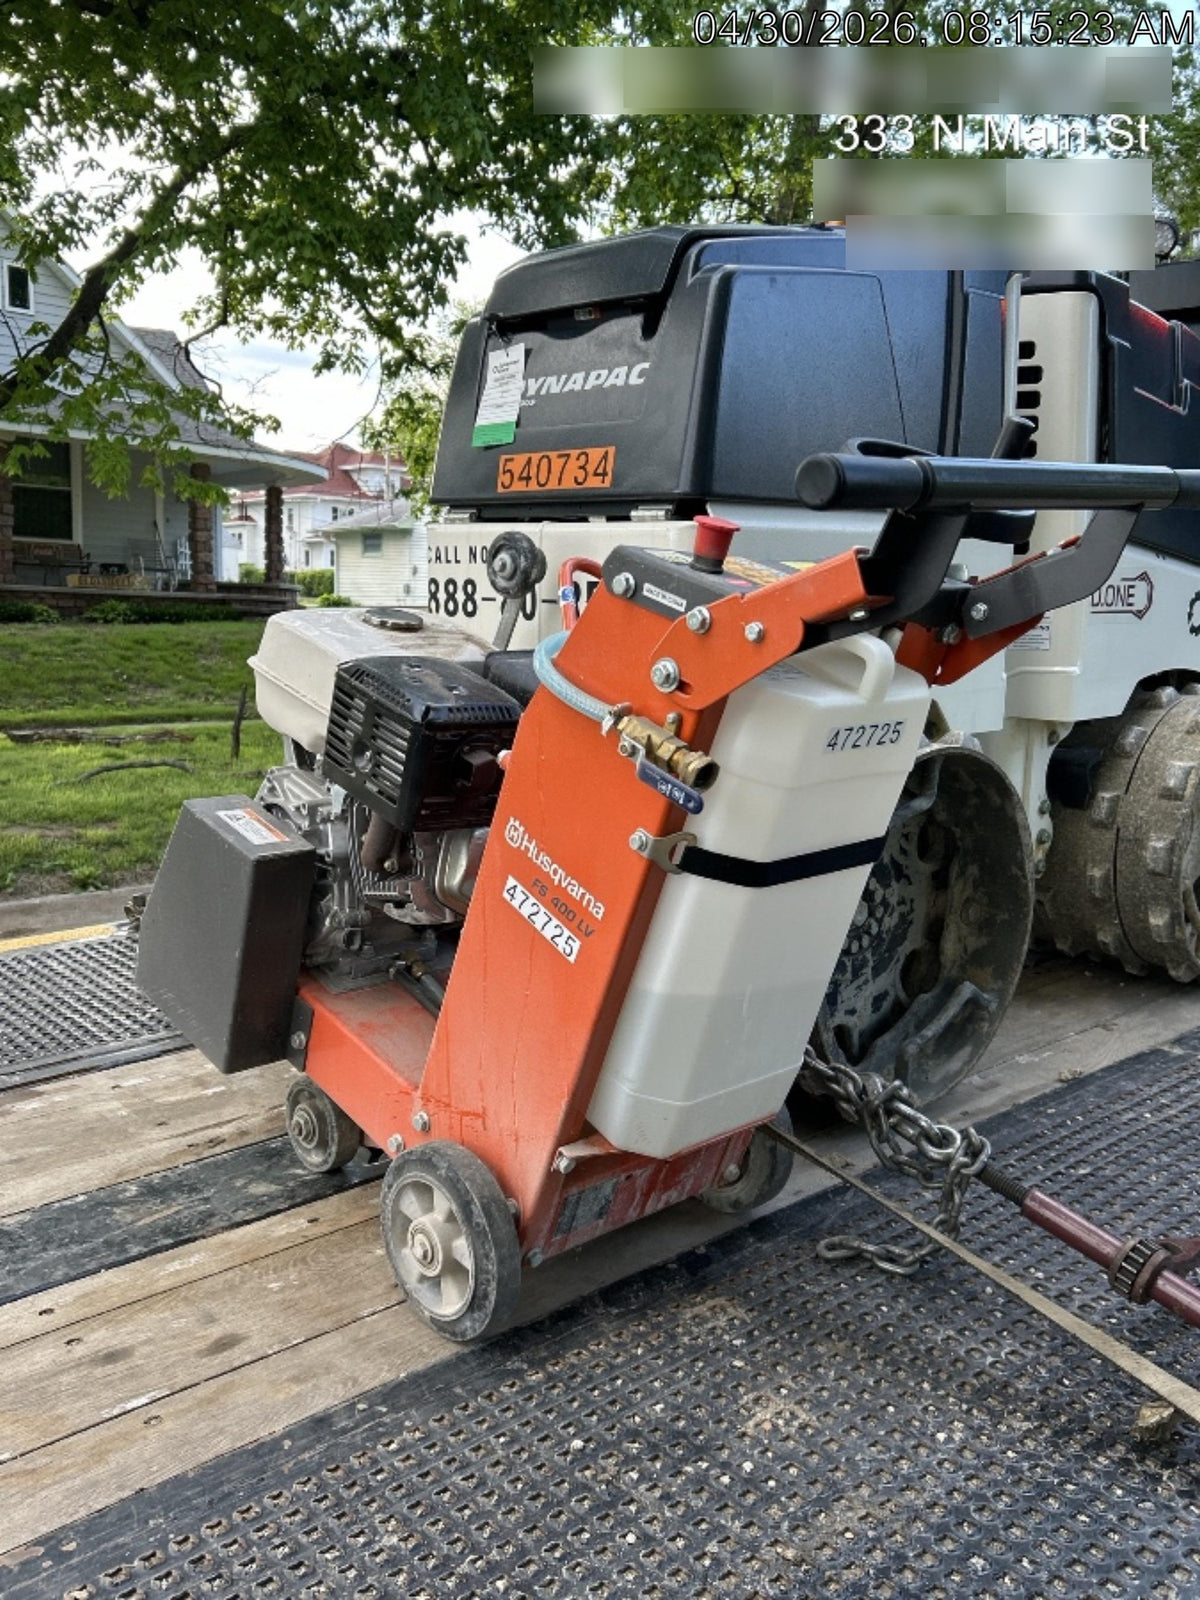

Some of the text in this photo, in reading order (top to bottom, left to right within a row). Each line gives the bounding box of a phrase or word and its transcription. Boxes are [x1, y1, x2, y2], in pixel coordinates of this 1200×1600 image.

[521, 362, 651, 397] YNAPAC
[501, 450, 610, 490] 540734
[468, 545, 489, 565] NO
[826, 721, 905, 752] 472725
[520, 833, 606, 921] Husqvarna
[505, 883, 577, 959] 472725
[532, 877, 596, 938] FS 400 LV
